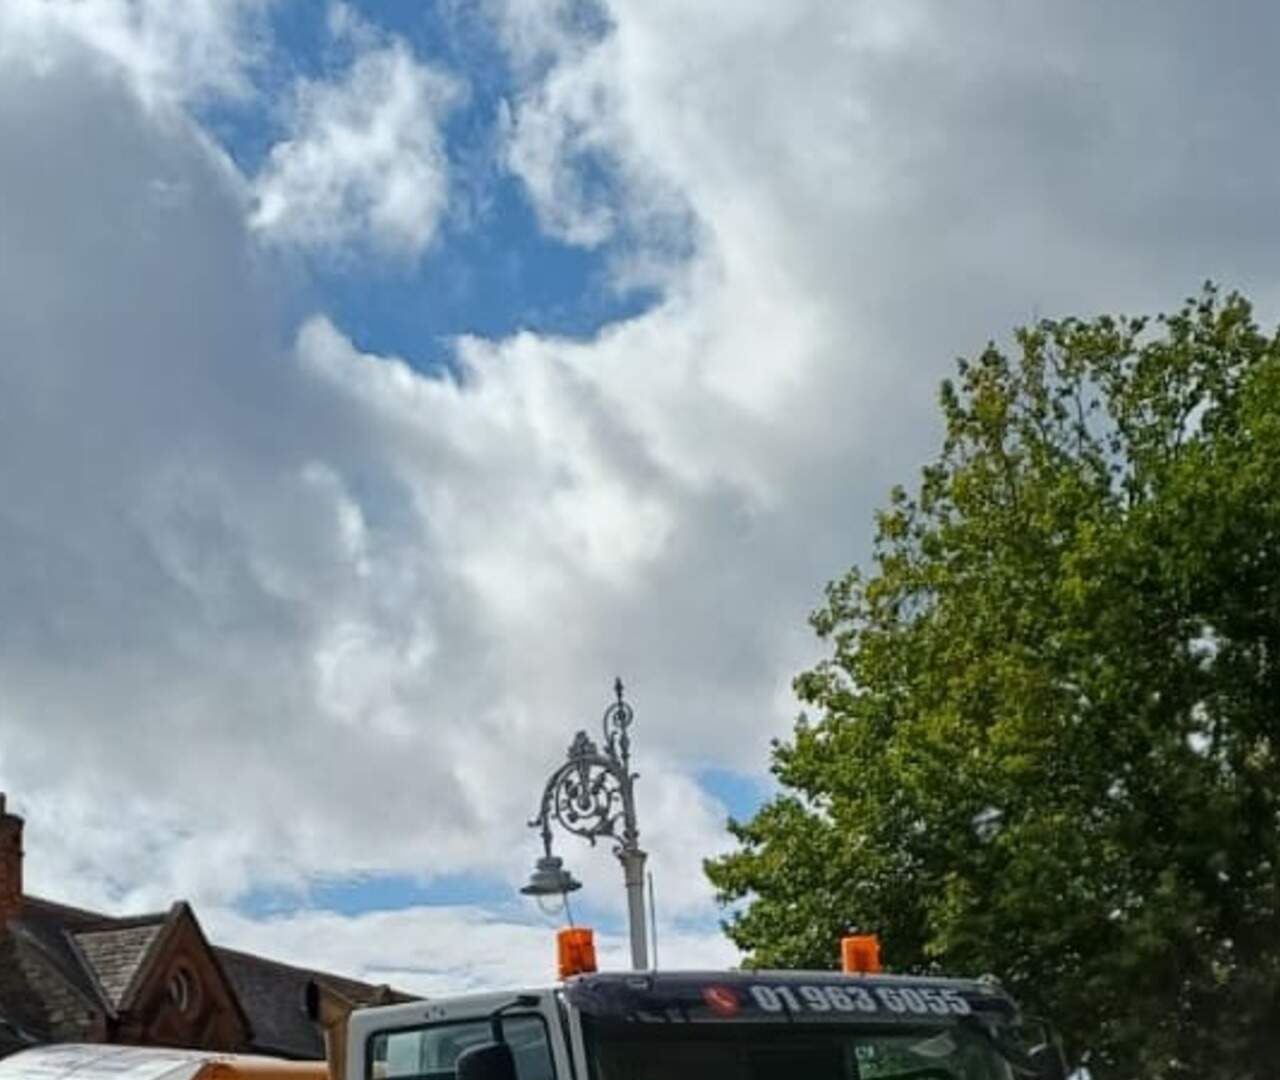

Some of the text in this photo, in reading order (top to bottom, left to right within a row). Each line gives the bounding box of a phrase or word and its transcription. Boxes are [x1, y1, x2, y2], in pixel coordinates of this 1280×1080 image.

[750, 985, 972, 1015] 01 963 6055
